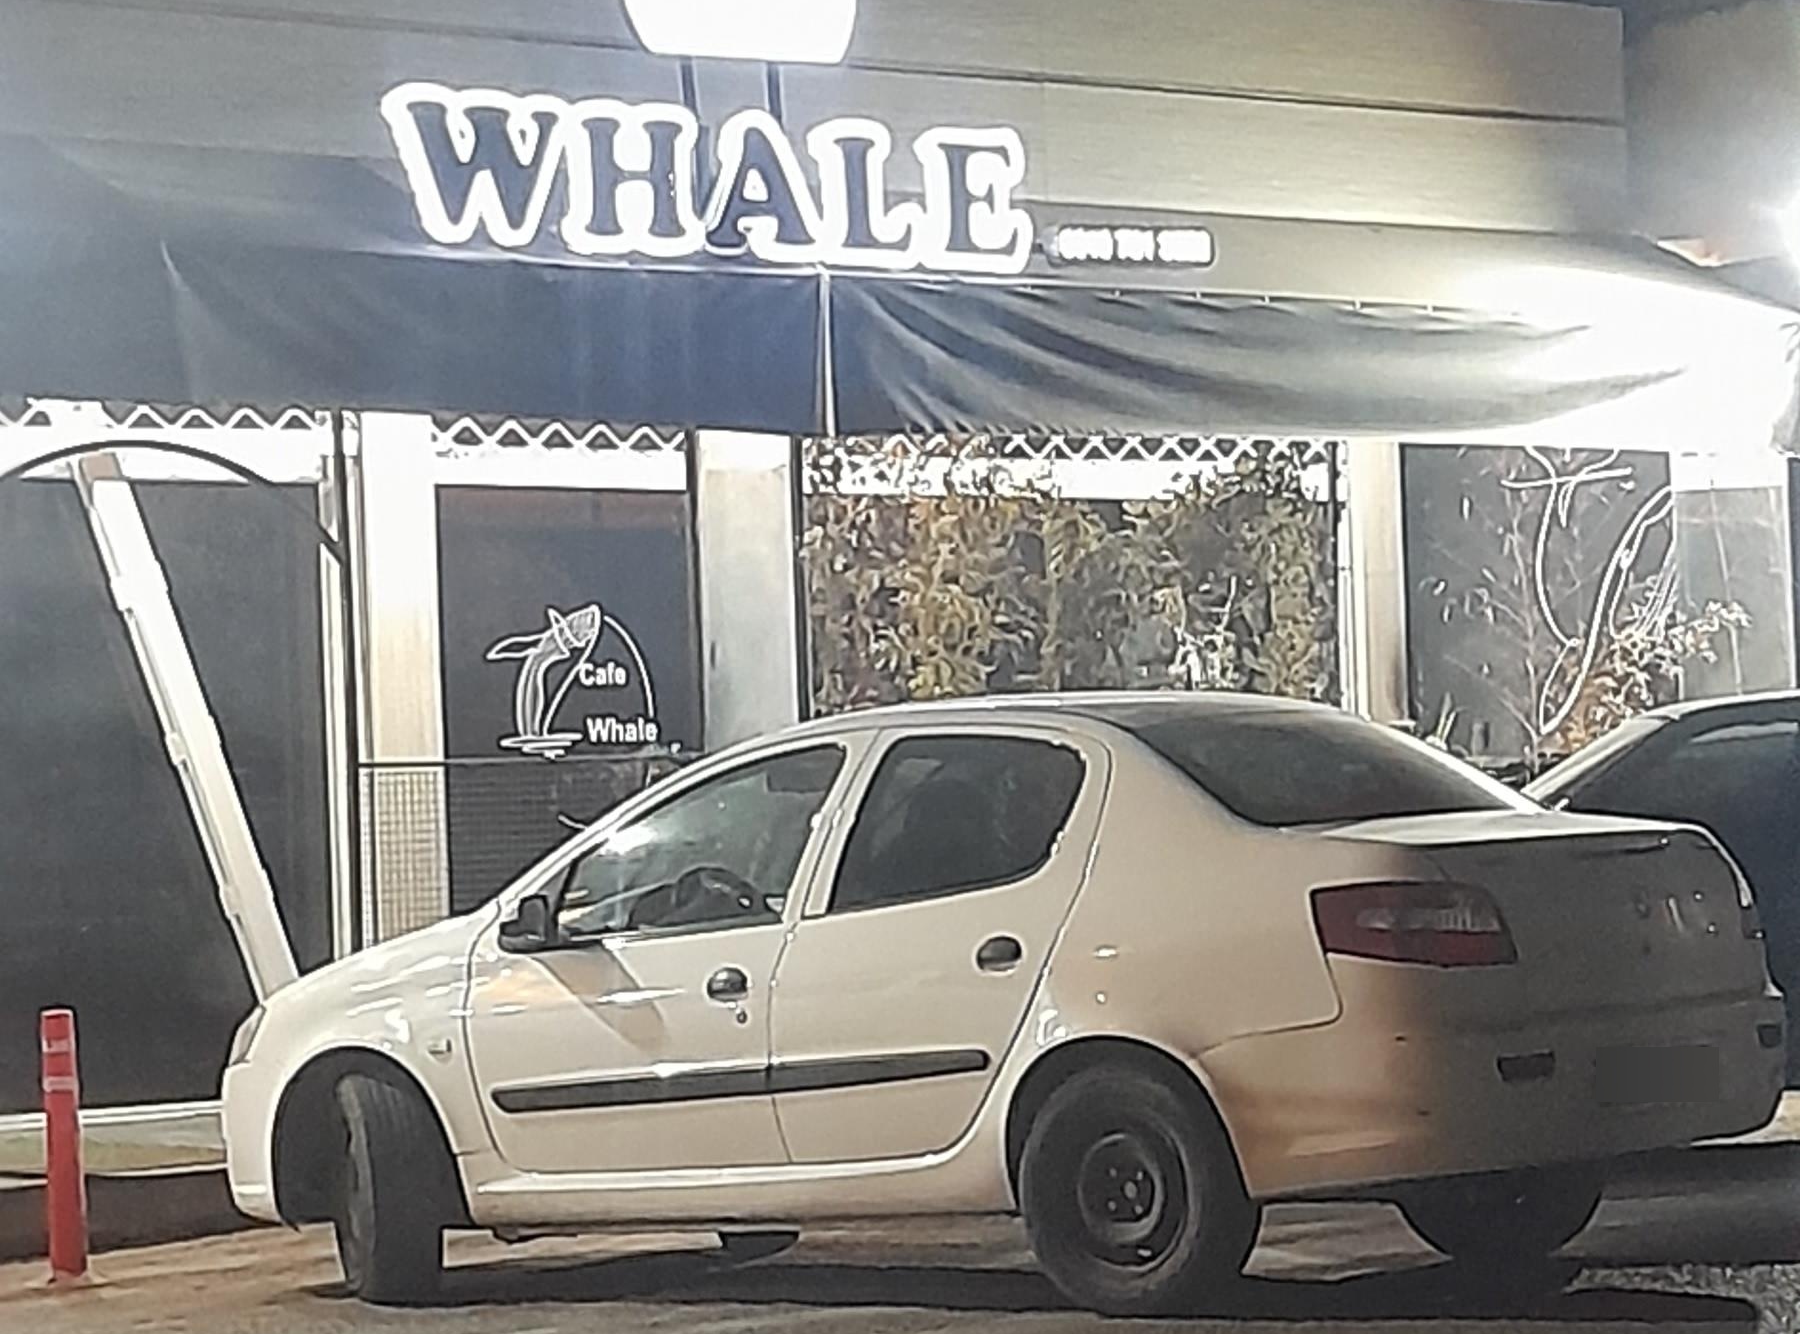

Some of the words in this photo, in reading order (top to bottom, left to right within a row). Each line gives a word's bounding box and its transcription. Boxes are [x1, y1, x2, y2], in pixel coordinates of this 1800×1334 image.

[386, 85, 1030, 270] WHALE
[580, 662, 627, 686] Cafe
[586, 717, 658, 743] Whale
